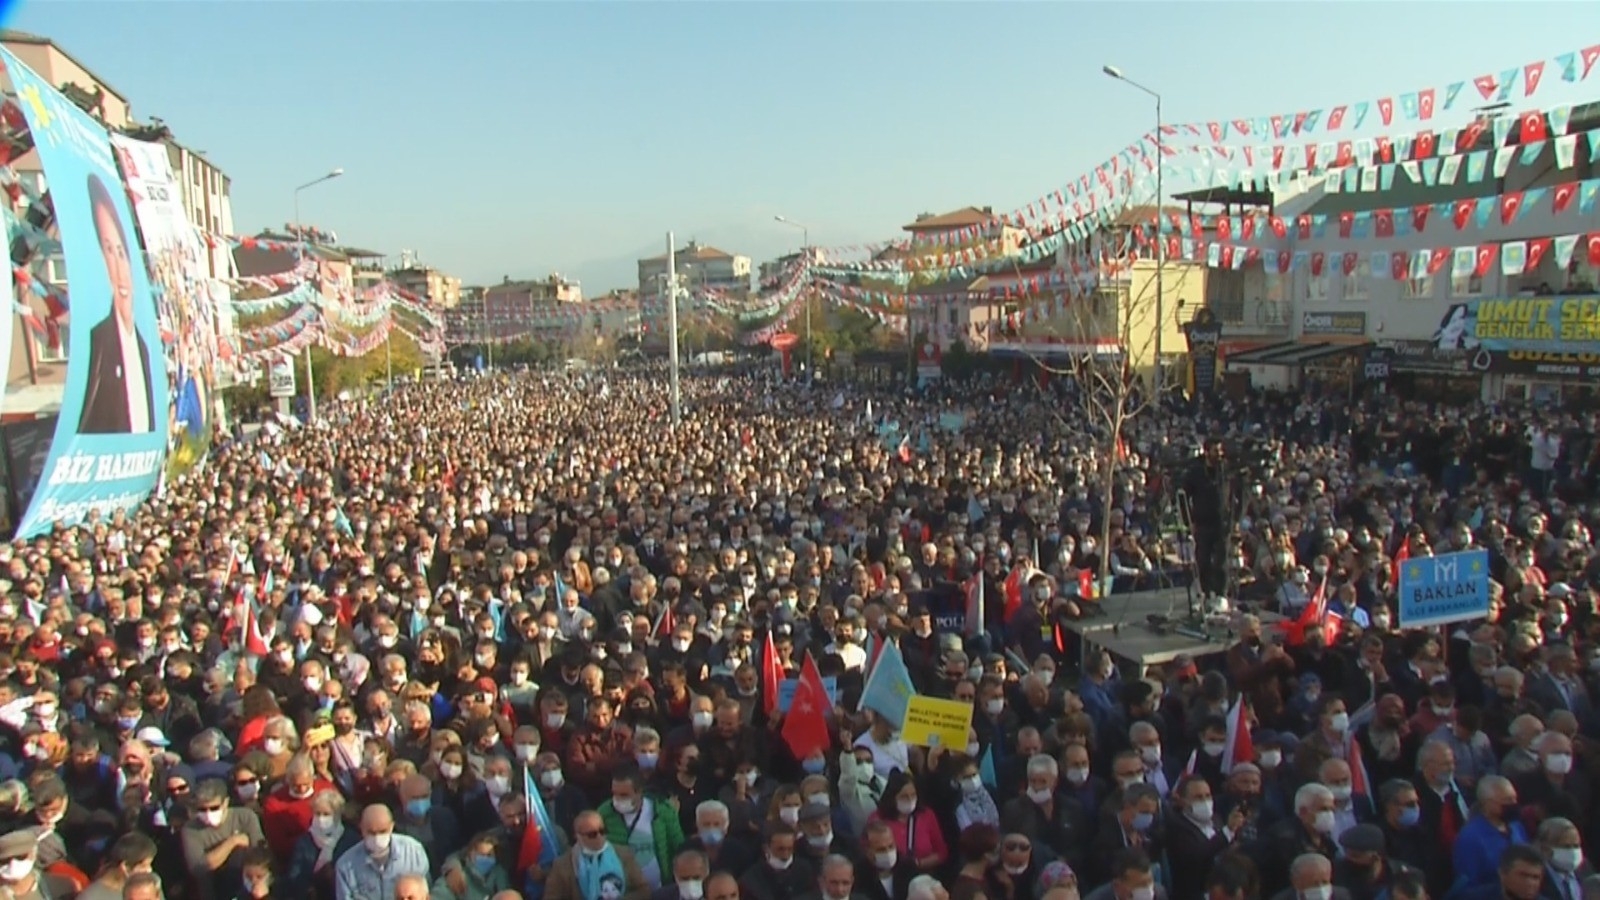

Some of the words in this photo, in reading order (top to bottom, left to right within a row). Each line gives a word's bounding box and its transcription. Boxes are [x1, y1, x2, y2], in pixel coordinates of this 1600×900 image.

[1478, 300, 1553, 322] UMUT
[1560, 300, 1600, 323] SE
[1537, 365, 1580, 375] MERCAN
[48, 449, 96, 486] BİZ
[1413, 580, 1477, 603] BAKLAN
